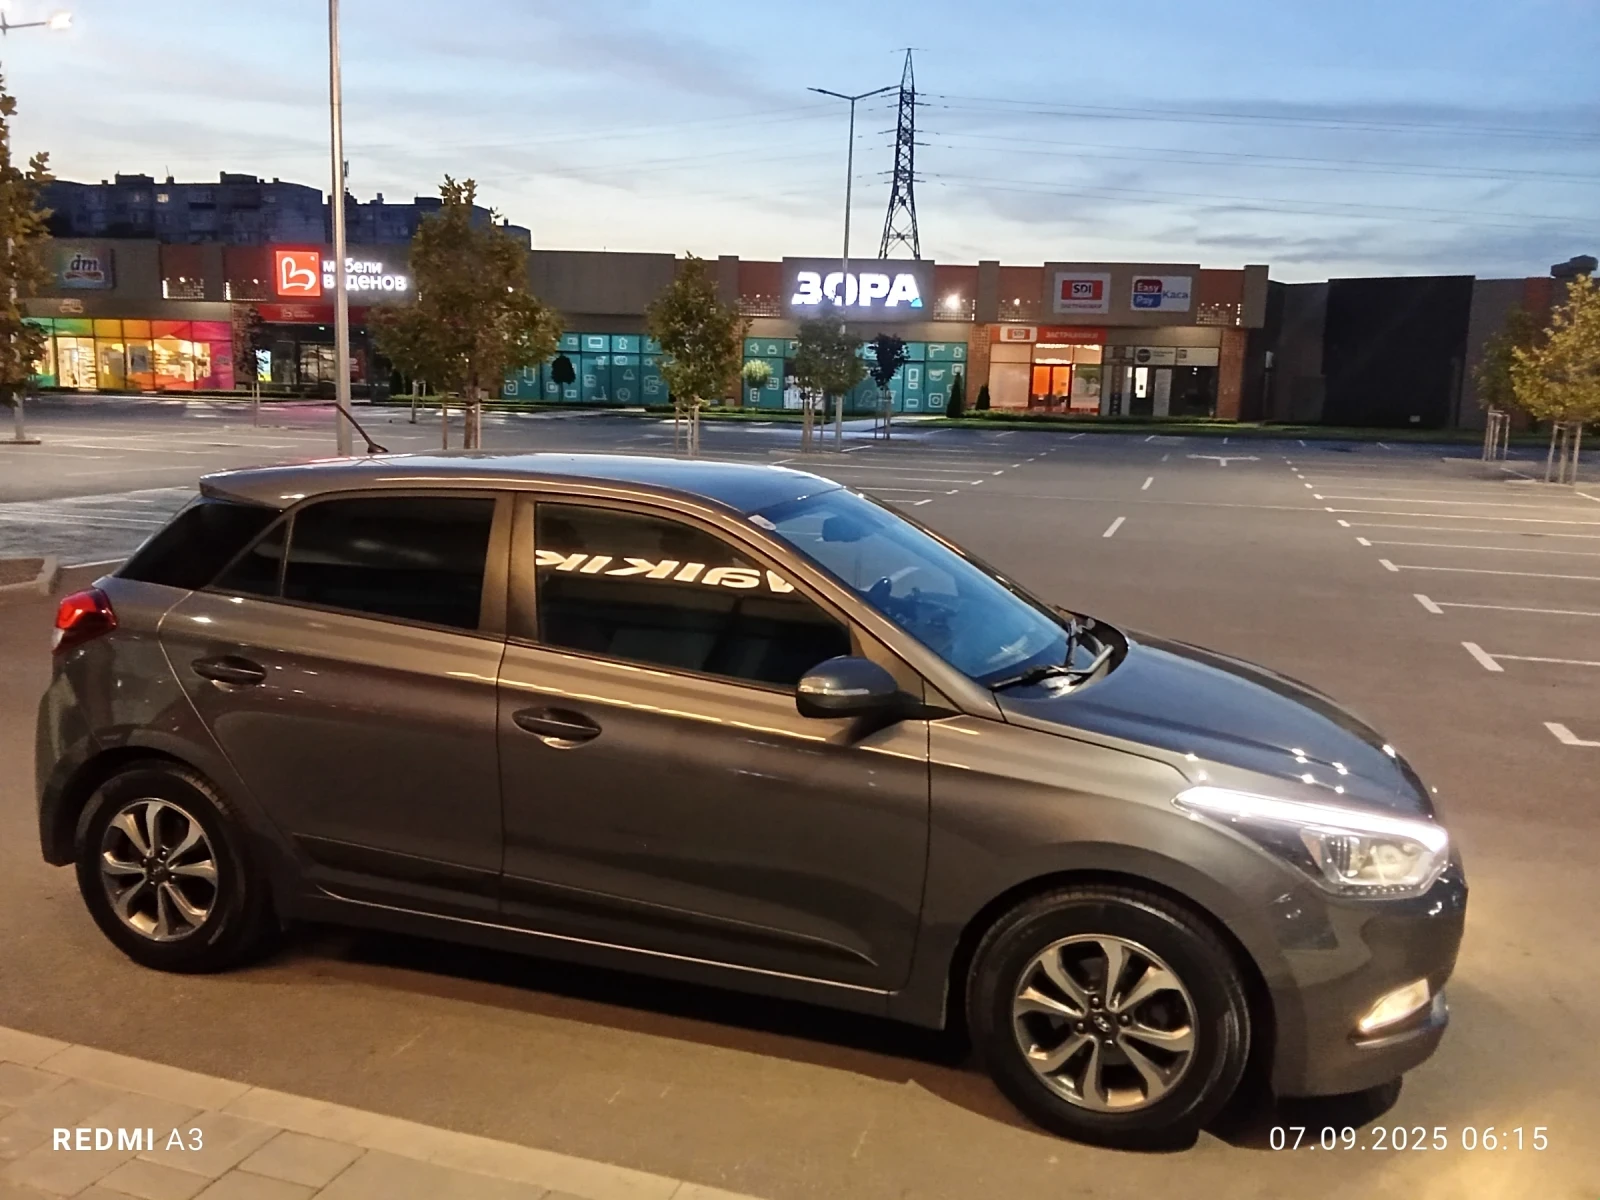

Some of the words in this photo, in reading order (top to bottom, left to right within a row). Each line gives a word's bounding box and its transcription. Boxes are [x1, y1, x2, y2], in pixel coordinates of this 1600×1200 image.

[70, 253, 98, 271] dm
[323, 258, 383, 274] мбели
[323, 274, 407, 291] вденов
[791, 271, 922, 308] ЗОРА
[1073, 284, 1092, 294] SDI
[1137, 282, 1160, 293] Easy
